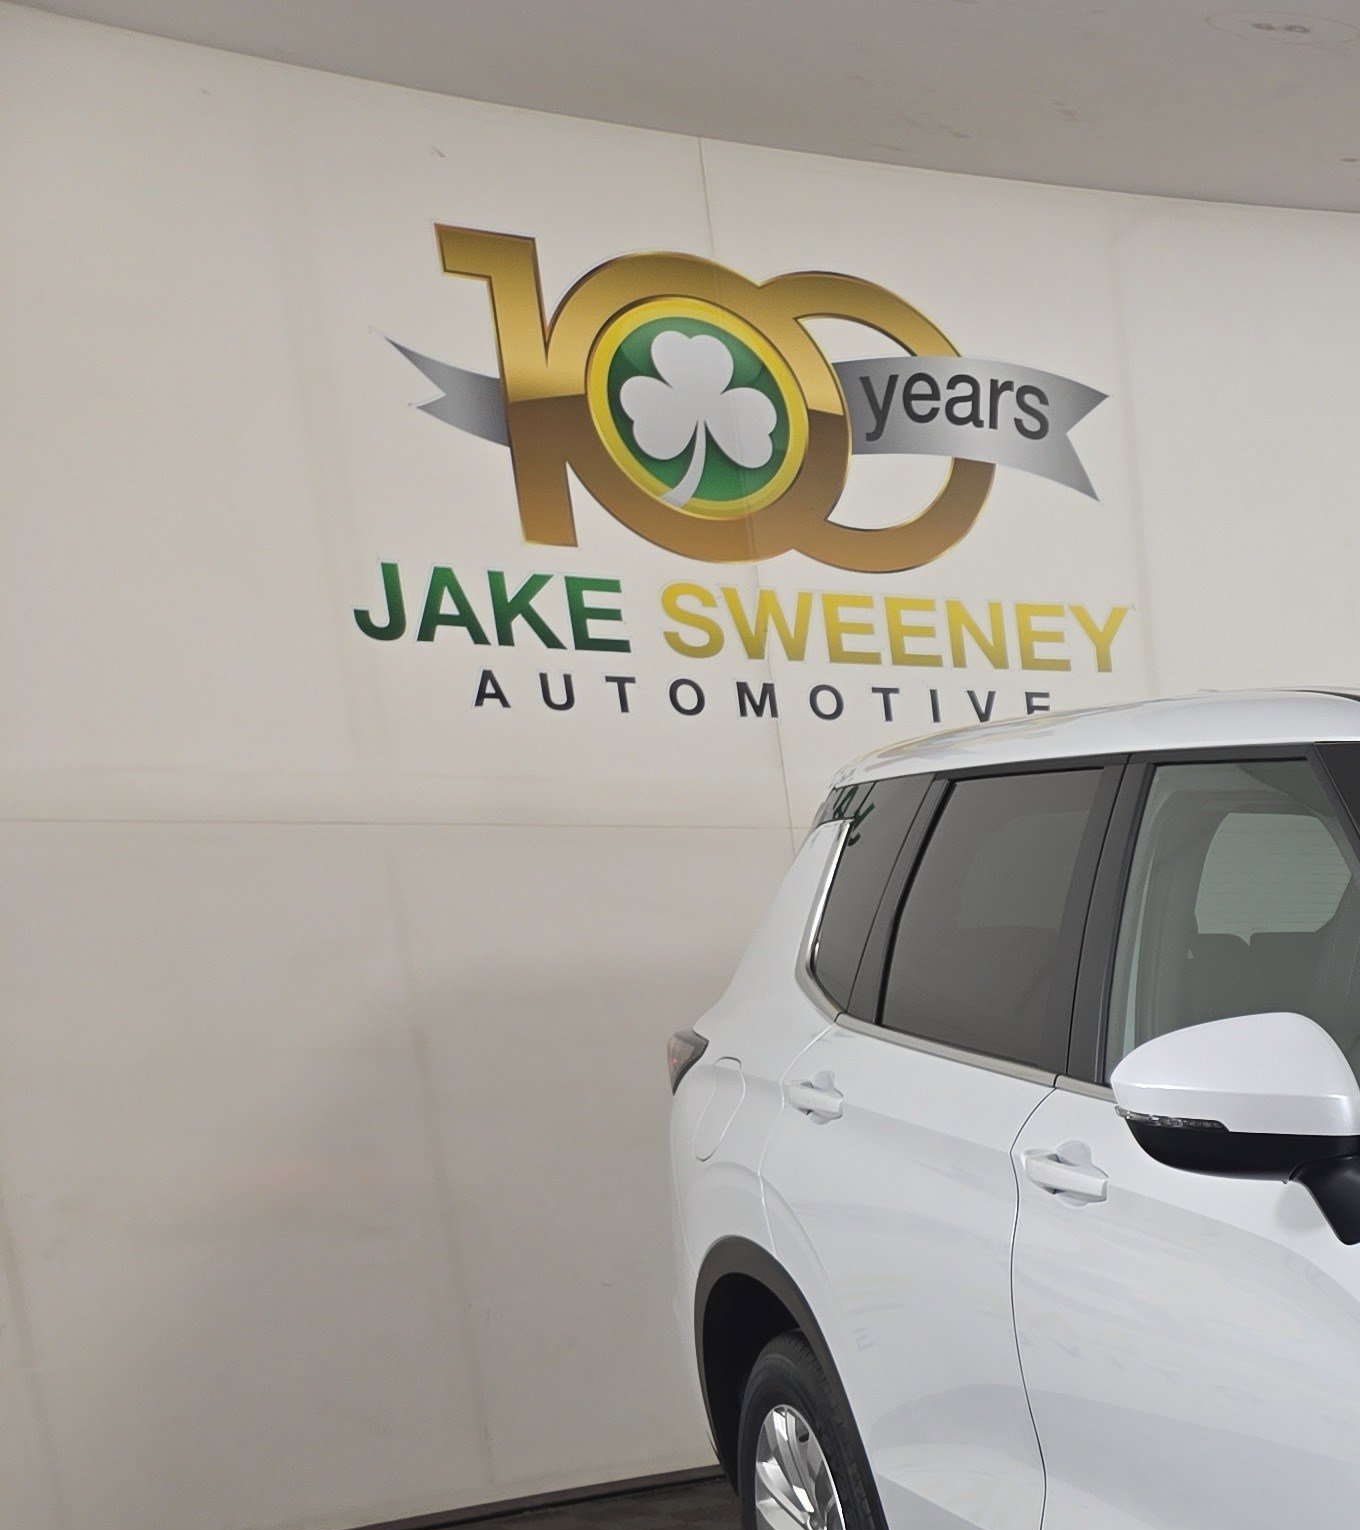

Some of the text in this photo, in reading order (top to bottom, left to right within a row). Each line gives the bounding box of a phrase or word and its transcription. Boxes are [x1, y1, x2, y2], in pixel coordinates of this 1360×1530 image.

[434, 224, 996, 574] 100
[859, 371, 1051, 441] years
[353, 562, 1130, 673] JAKE SWEENEY
[474, 668, 1051, 724] AUTOMOTIVE
